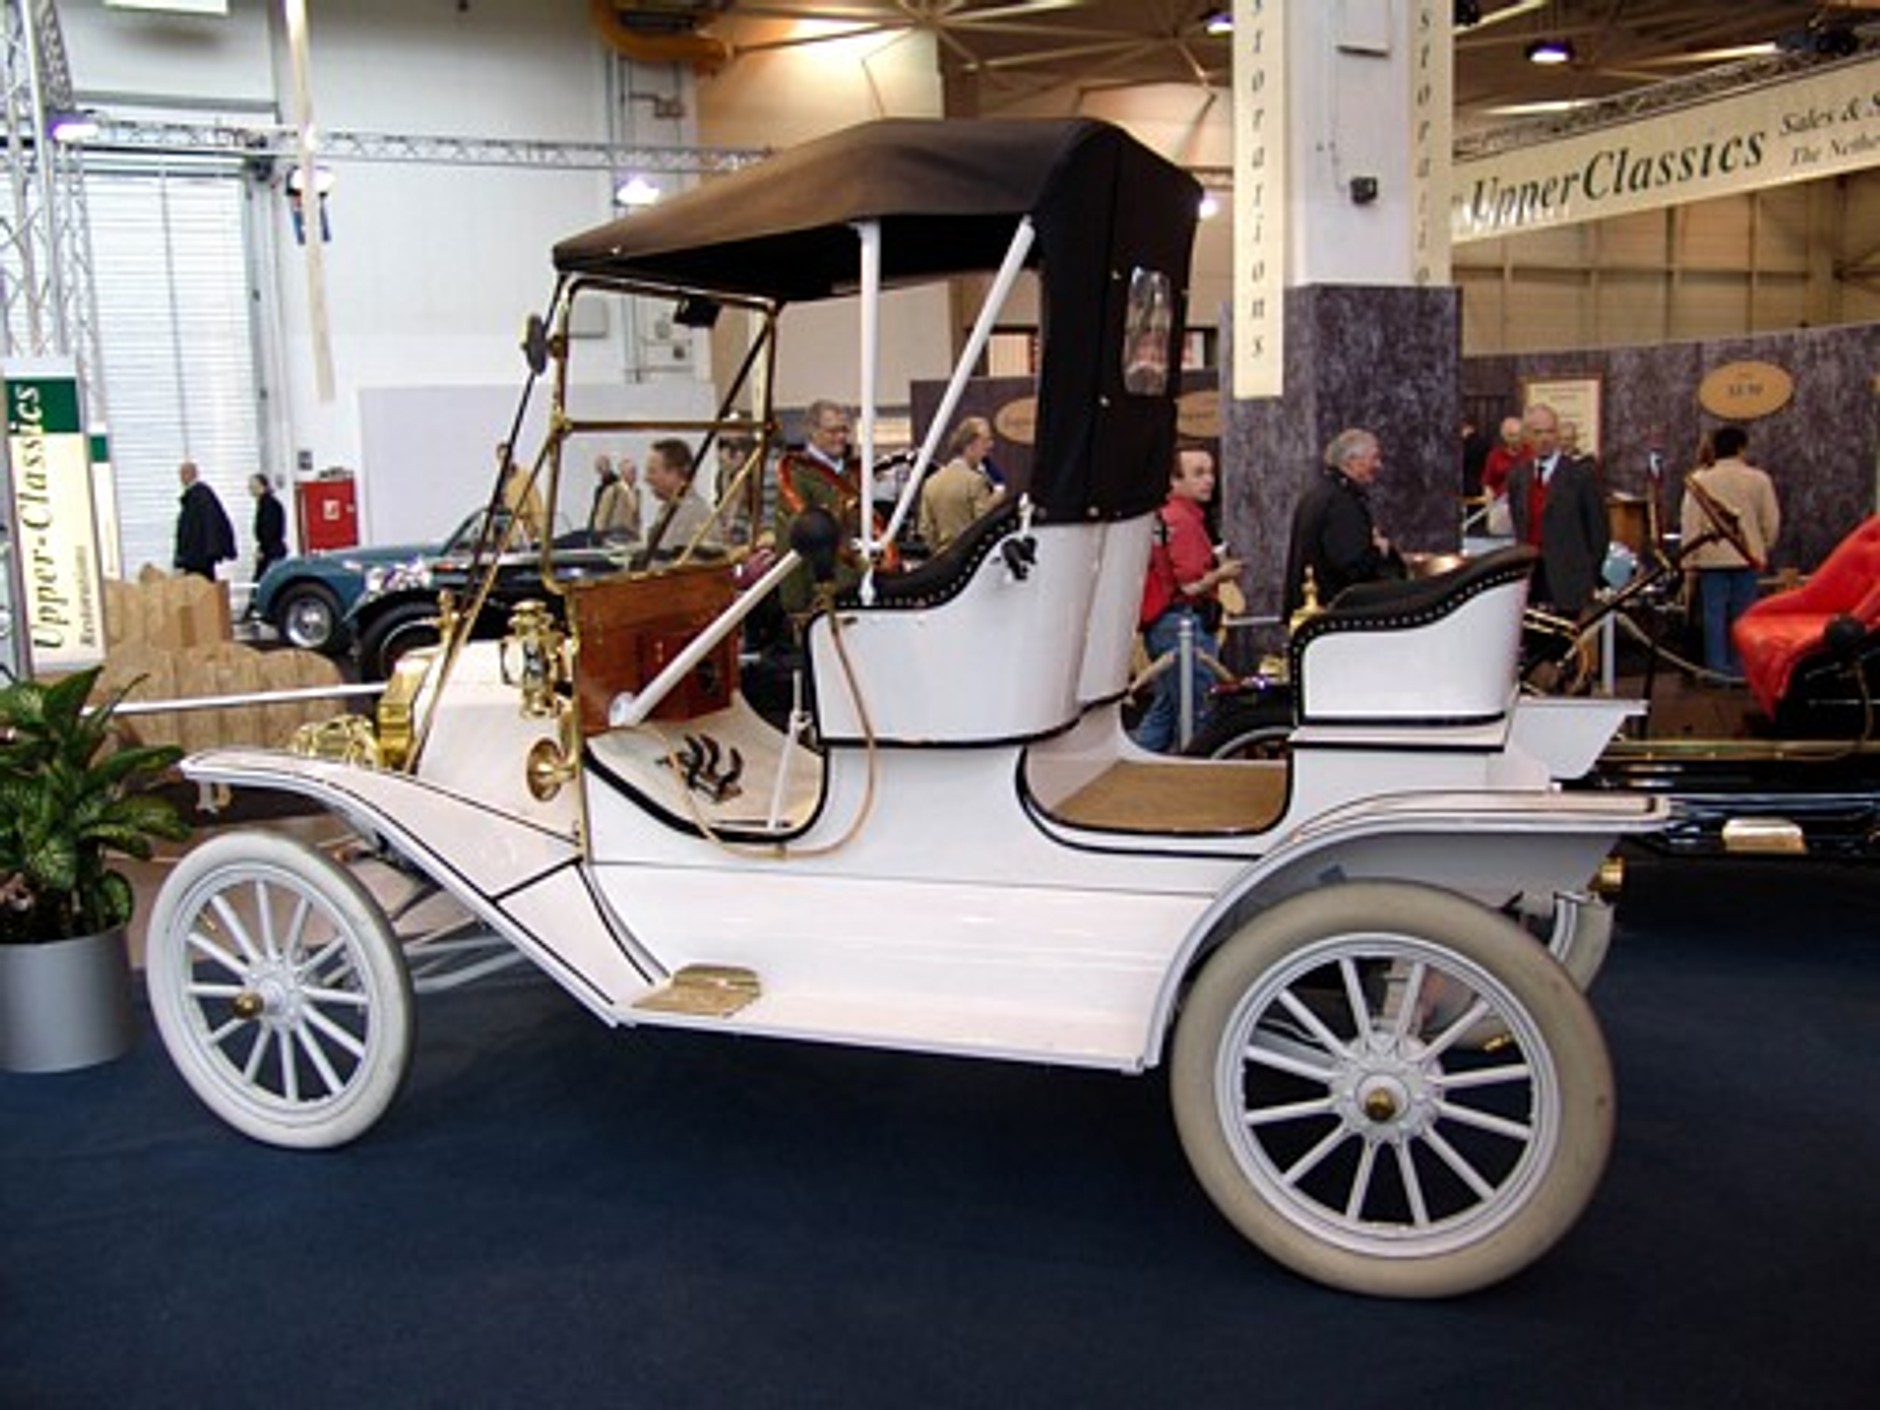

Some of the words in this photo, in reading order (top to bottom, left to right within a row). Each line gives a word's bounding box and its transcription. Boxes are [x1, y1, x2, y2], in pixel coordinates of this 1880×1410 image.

[1779, 108, 1836, 137] Sales
[1841, 96, 1860, 122] &
[1789, 146, 1822, 167] The
[10, 384, 69, 648] Upper-Classics
